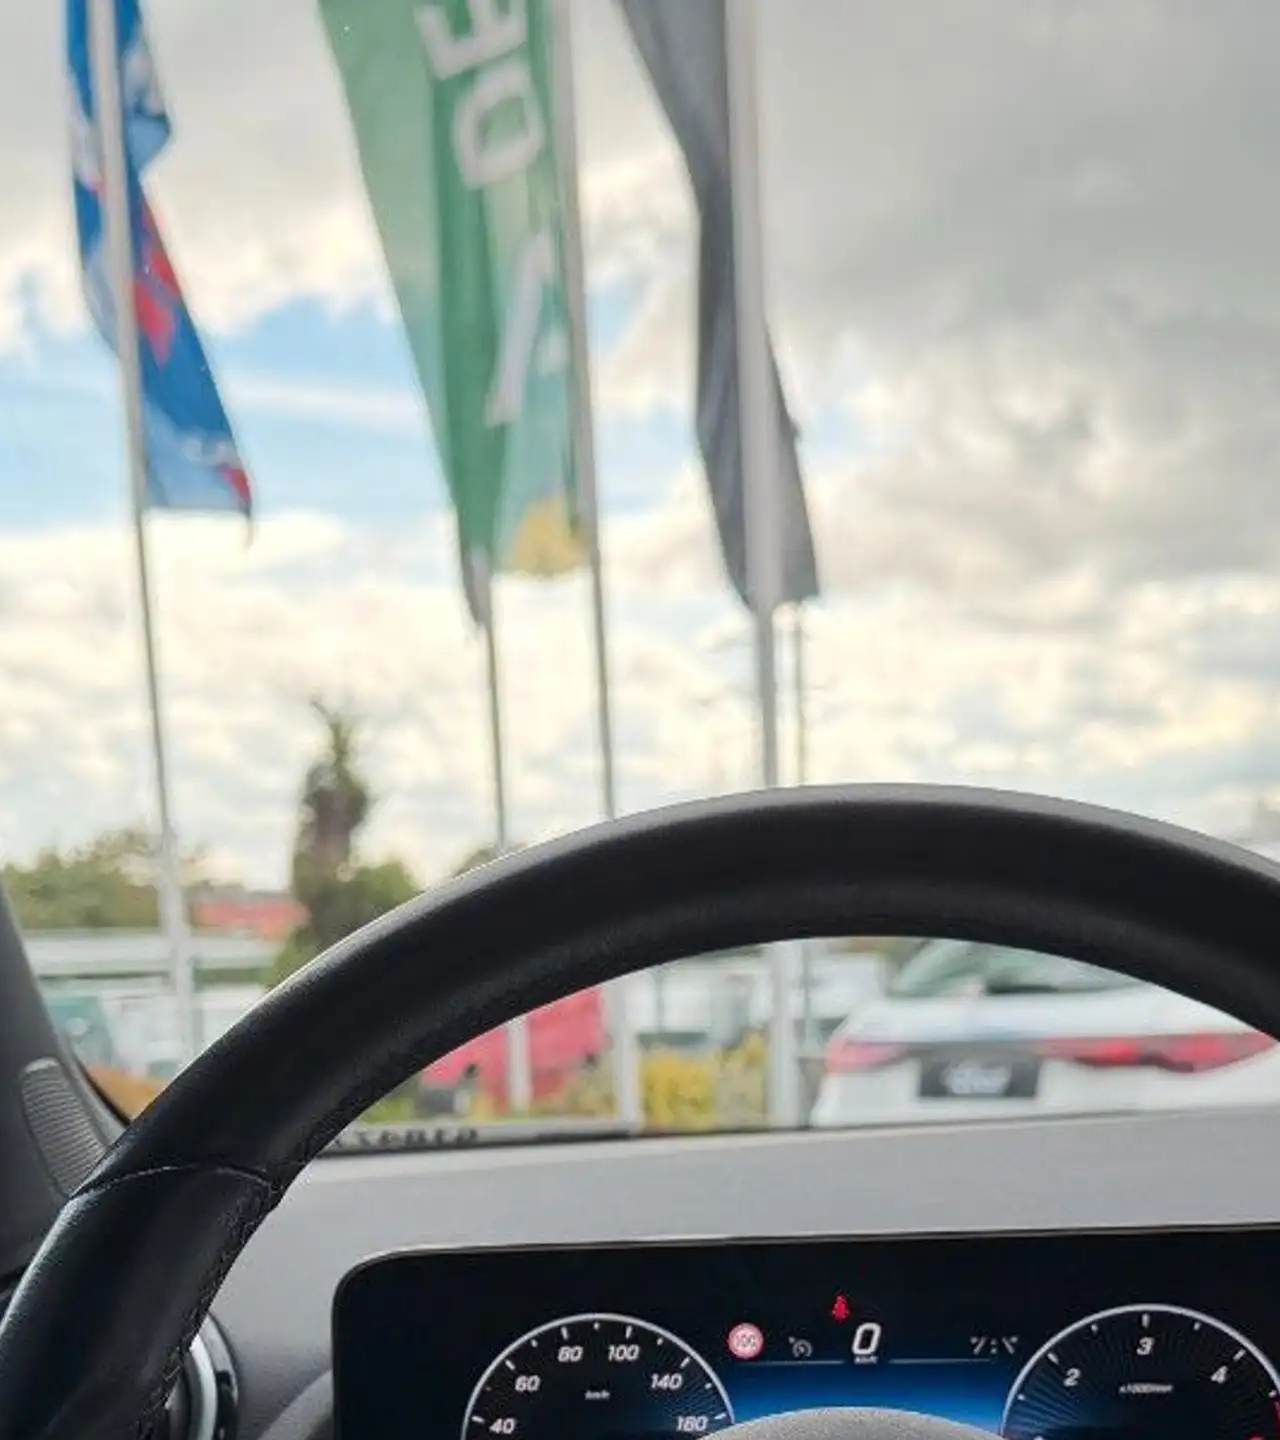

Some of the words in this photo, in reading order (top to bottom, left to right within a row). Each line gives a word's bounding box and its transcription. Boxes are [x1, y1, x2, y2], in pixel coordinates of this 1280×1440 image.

[852, 1322, 881, 1355] 0
[1136, 1337, 1155, 1355] 3
[558, 1347, 583, 1362] 80
[608, 1345, 640, 1361] 100
[651, 1374, 682, 1389] 140
[1064, 1368, 1080, 1387] 2
[1210, 1366, 1228, 1383] 4
[514, 1375, 541, 1391] 60
[489, 1418, 516, 1434] 40
